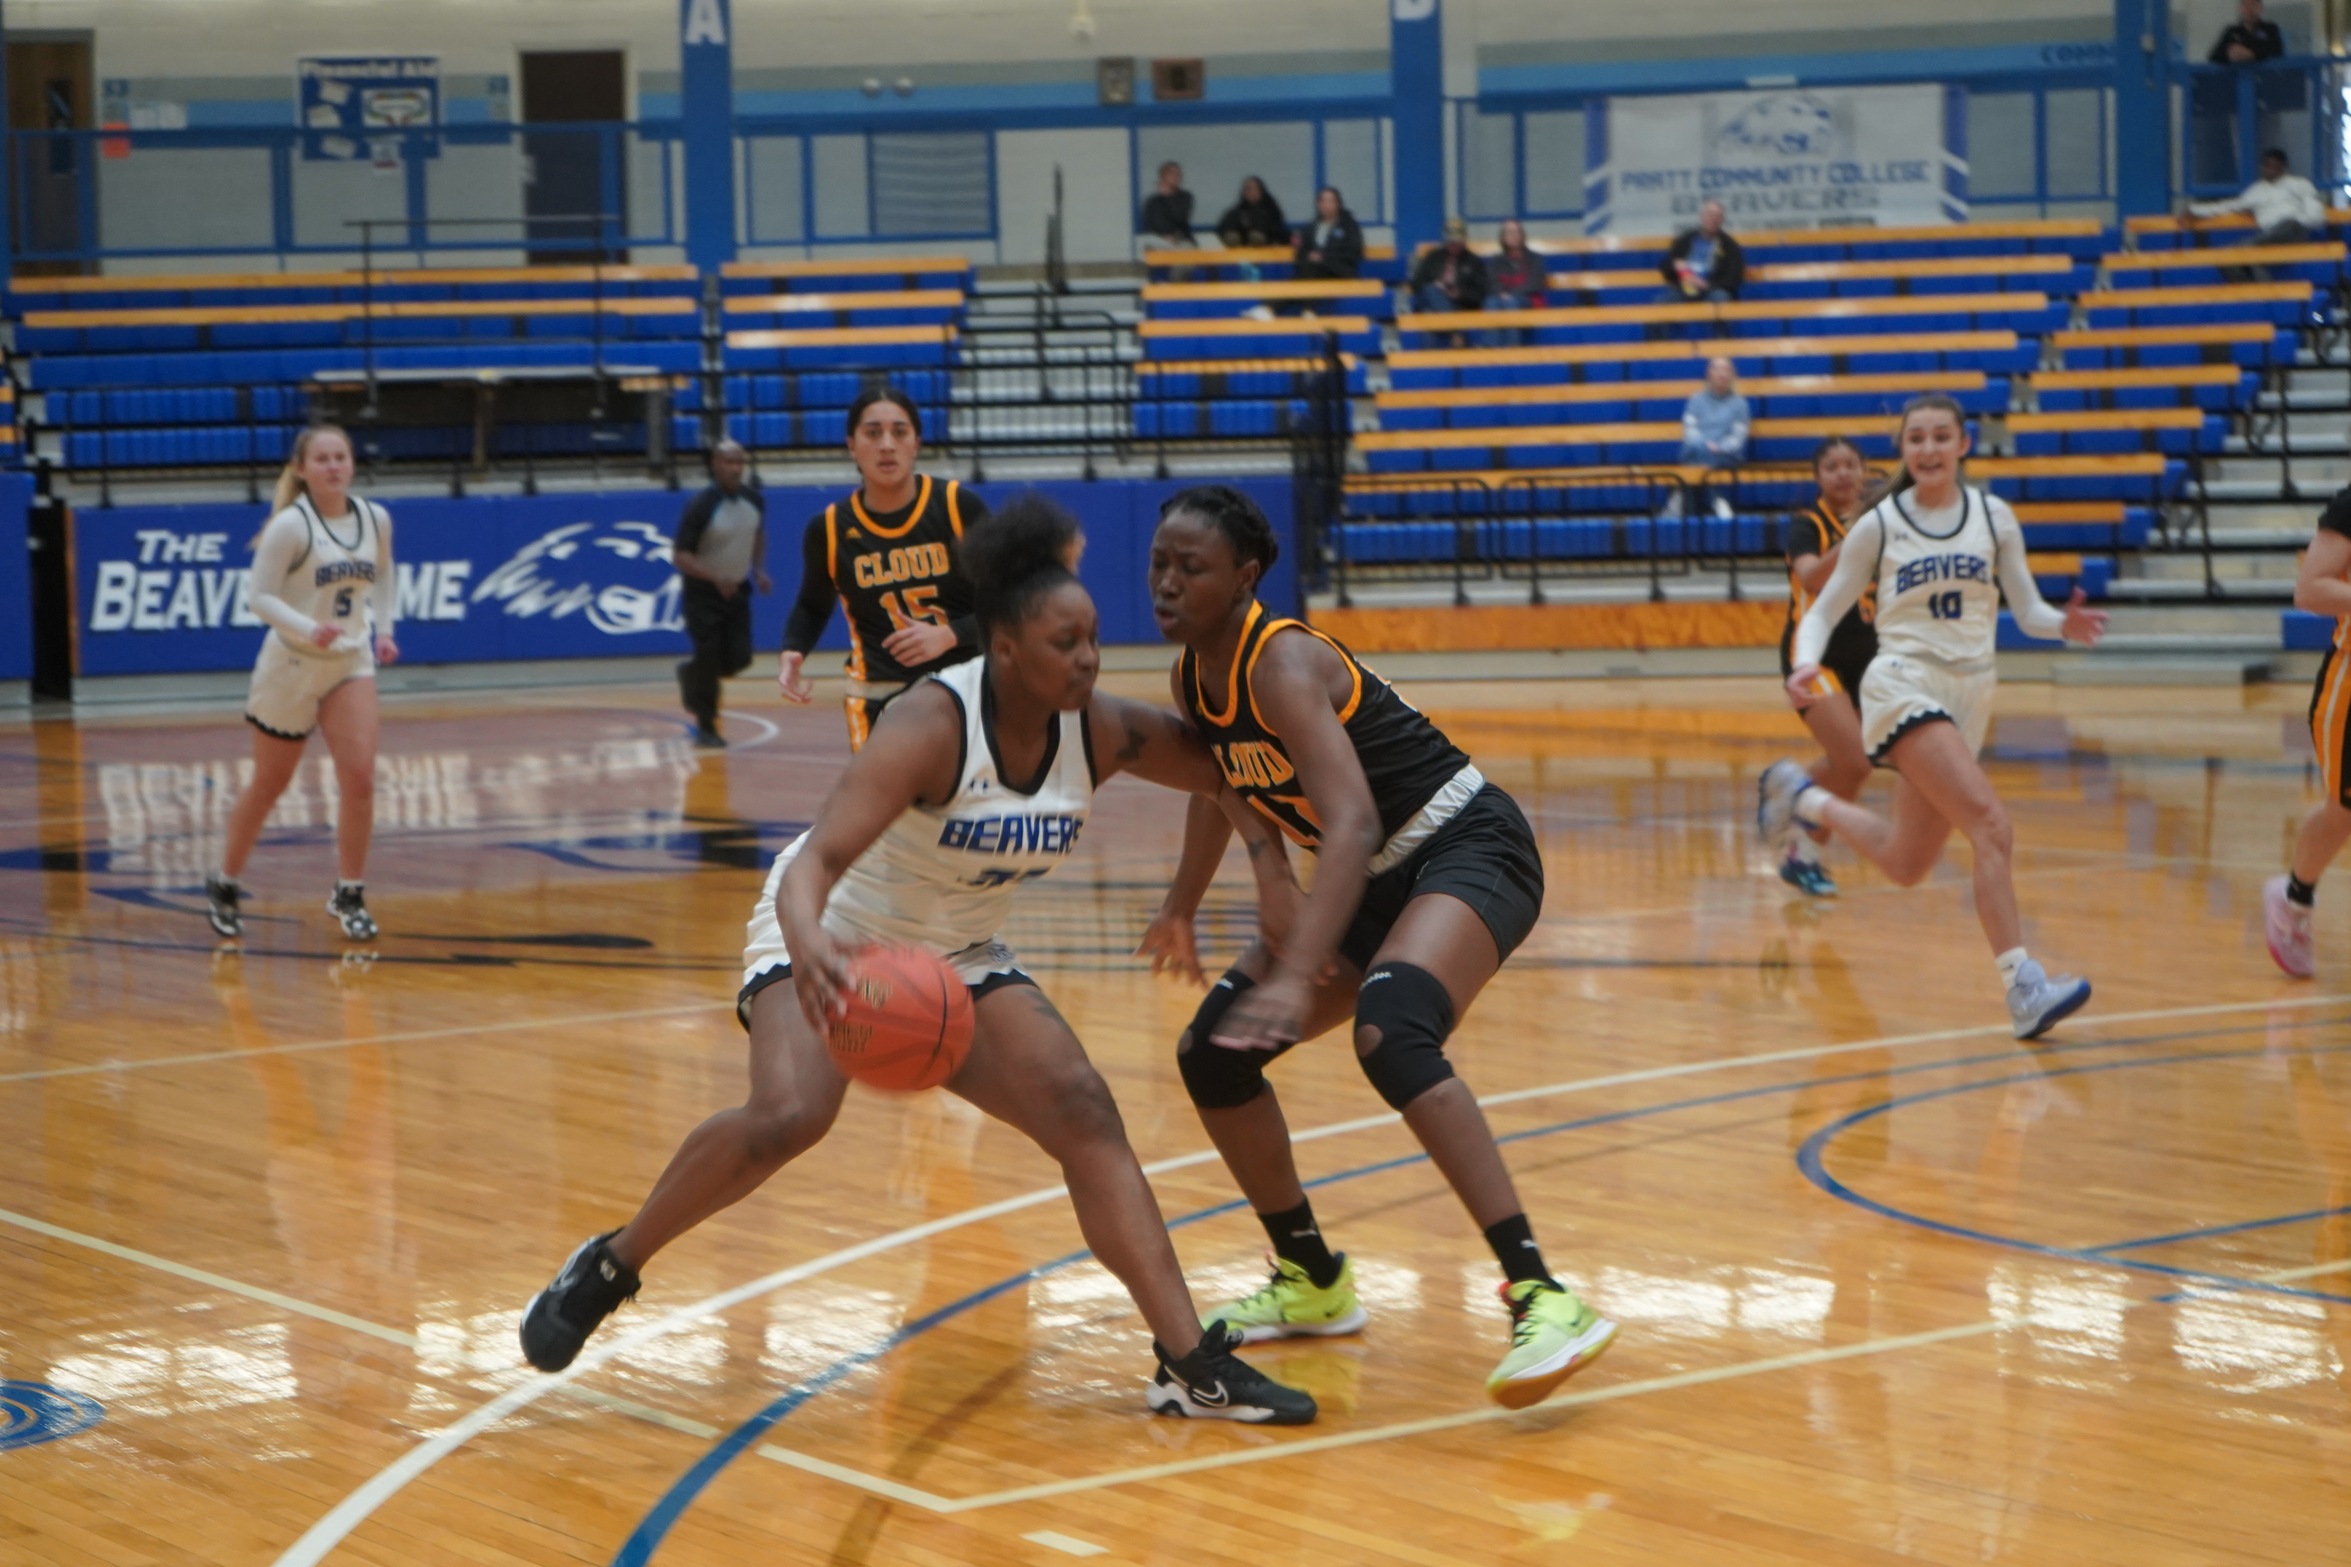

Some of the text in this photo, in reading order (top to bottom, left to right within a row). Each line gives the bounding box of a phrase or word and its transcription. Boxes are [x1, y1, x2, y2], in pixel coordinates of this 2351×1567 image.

[1699, 163, 1820, 189] COMMUNITY
[1828, 160, 1930, 184] COLLEGE
[135, 529, 228, 564] THE
[854, 542, 950, 588] CLOUD
[89, 560, 266, 632] BEAVE
[335, 586, 354, 617] 5
[1928, 590, 1962, 619] 10
[1210, 741, 1294, 789] LOUD
